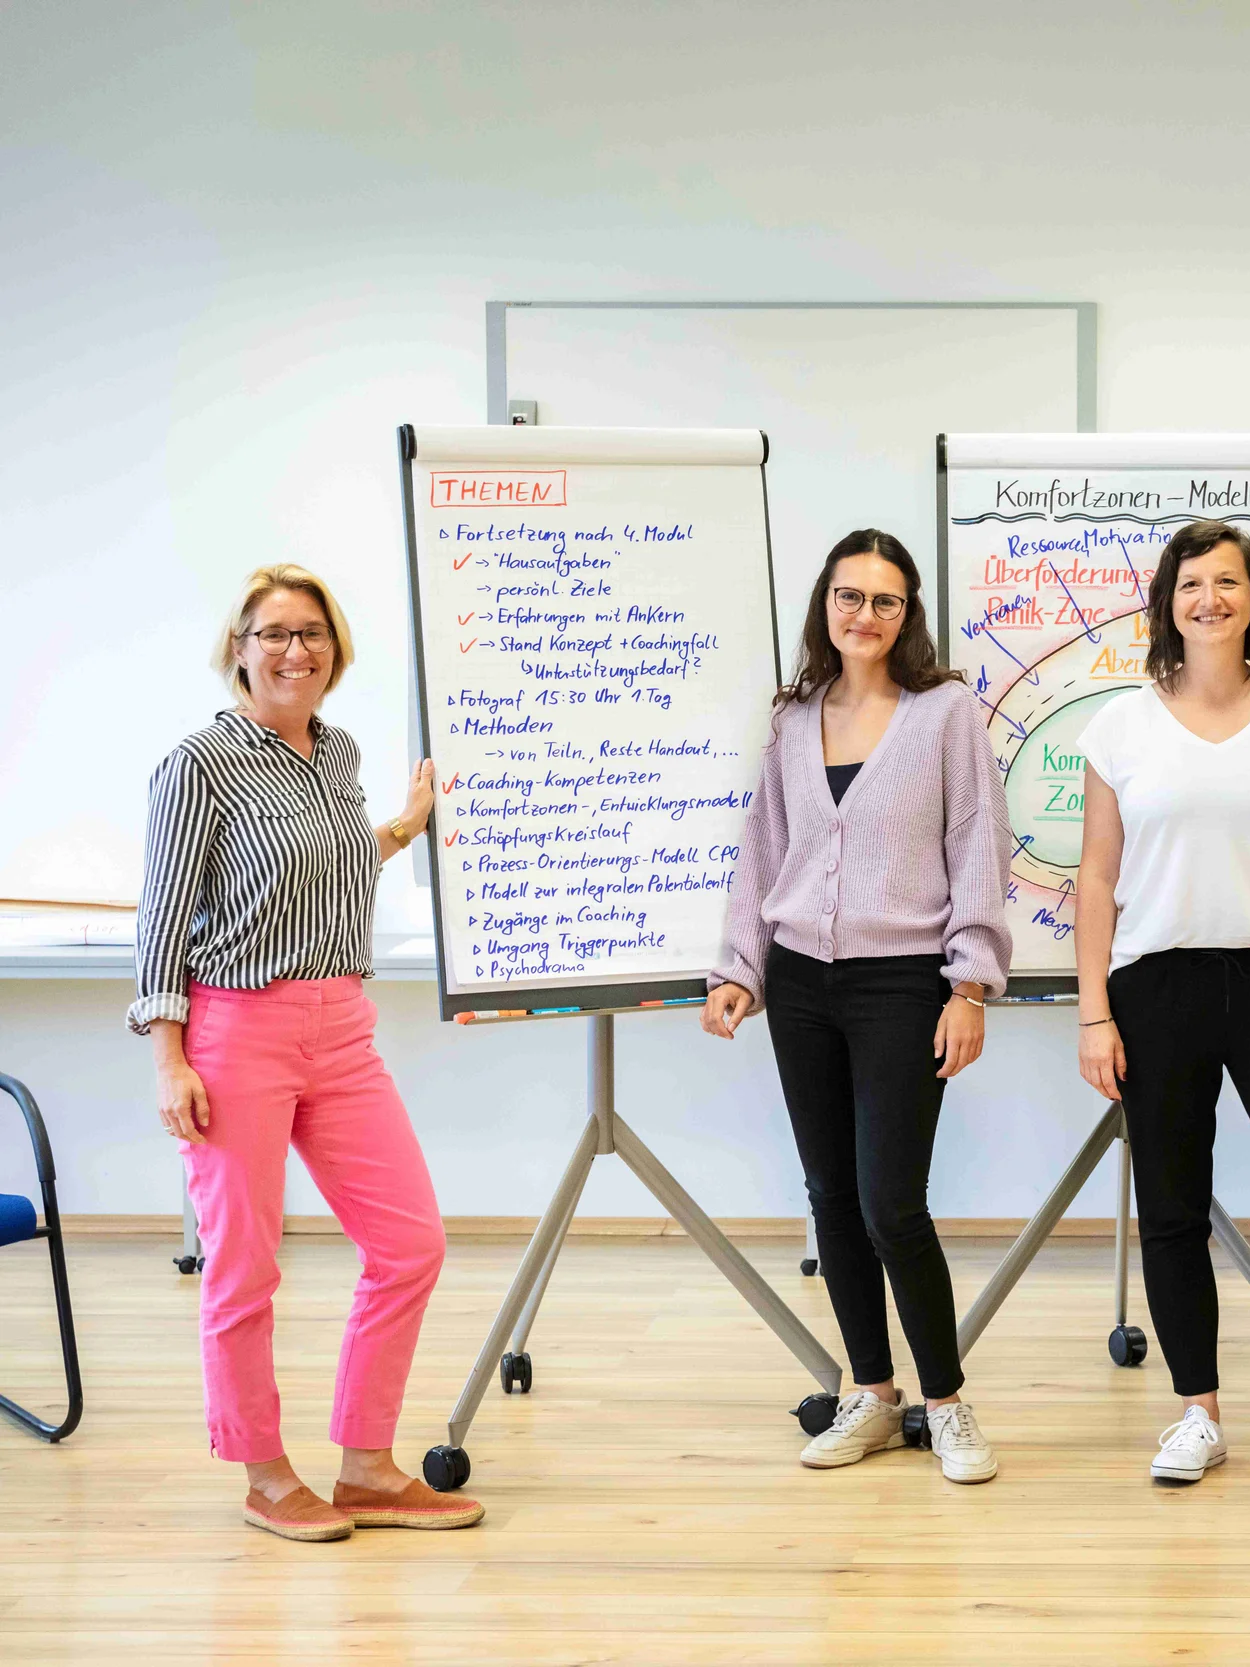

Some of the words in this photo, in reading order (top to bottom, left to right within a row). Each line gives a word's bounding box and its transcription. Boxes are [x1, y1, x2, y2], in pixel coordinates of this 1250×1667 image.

[439, 479, 553, 503] THEMEN
[456, 523, 566, 554] Fortsetzung
[575, 526, 614, 542] nach
[644, 525, 694, 541] Modul
[1084, 524, 1171, 549] Motivatio
[496, 580, 565, 603] persönl.
[571, 580, 612, 597] Ziele
[498, 608, 586, 632] Erfahrungen
[595, 609, 622, 623] mit
[499, 636, 542, 652] Stand
[549, 633, 613, 659] Konzept
[460, 689, 525, 714] Fotograf
[535, 691, 586, 706] 15:30
[594, 691, 623, 704] Uhr
[464, 716, 554, 735] Methoden
[510, 749, 537, 761] von
[599, 740, 643, 757] Reste
[600, 791, 753, 820] Entwicklungsmodell
[481, 881, 528, 899] Modell
[534, 885, 559, 898] zur
[566, 877, 644, 902] integralen
[483, 911, 549, 935] Zugänge
[556, 912, 573, 925] im
[578, 904, 647, 928] Coaching
[487, 939, 550, 963] Umgang
[559, 930, 666, 958] Triggerpunkte
[490, 960, 585, 983] Psychodrama
